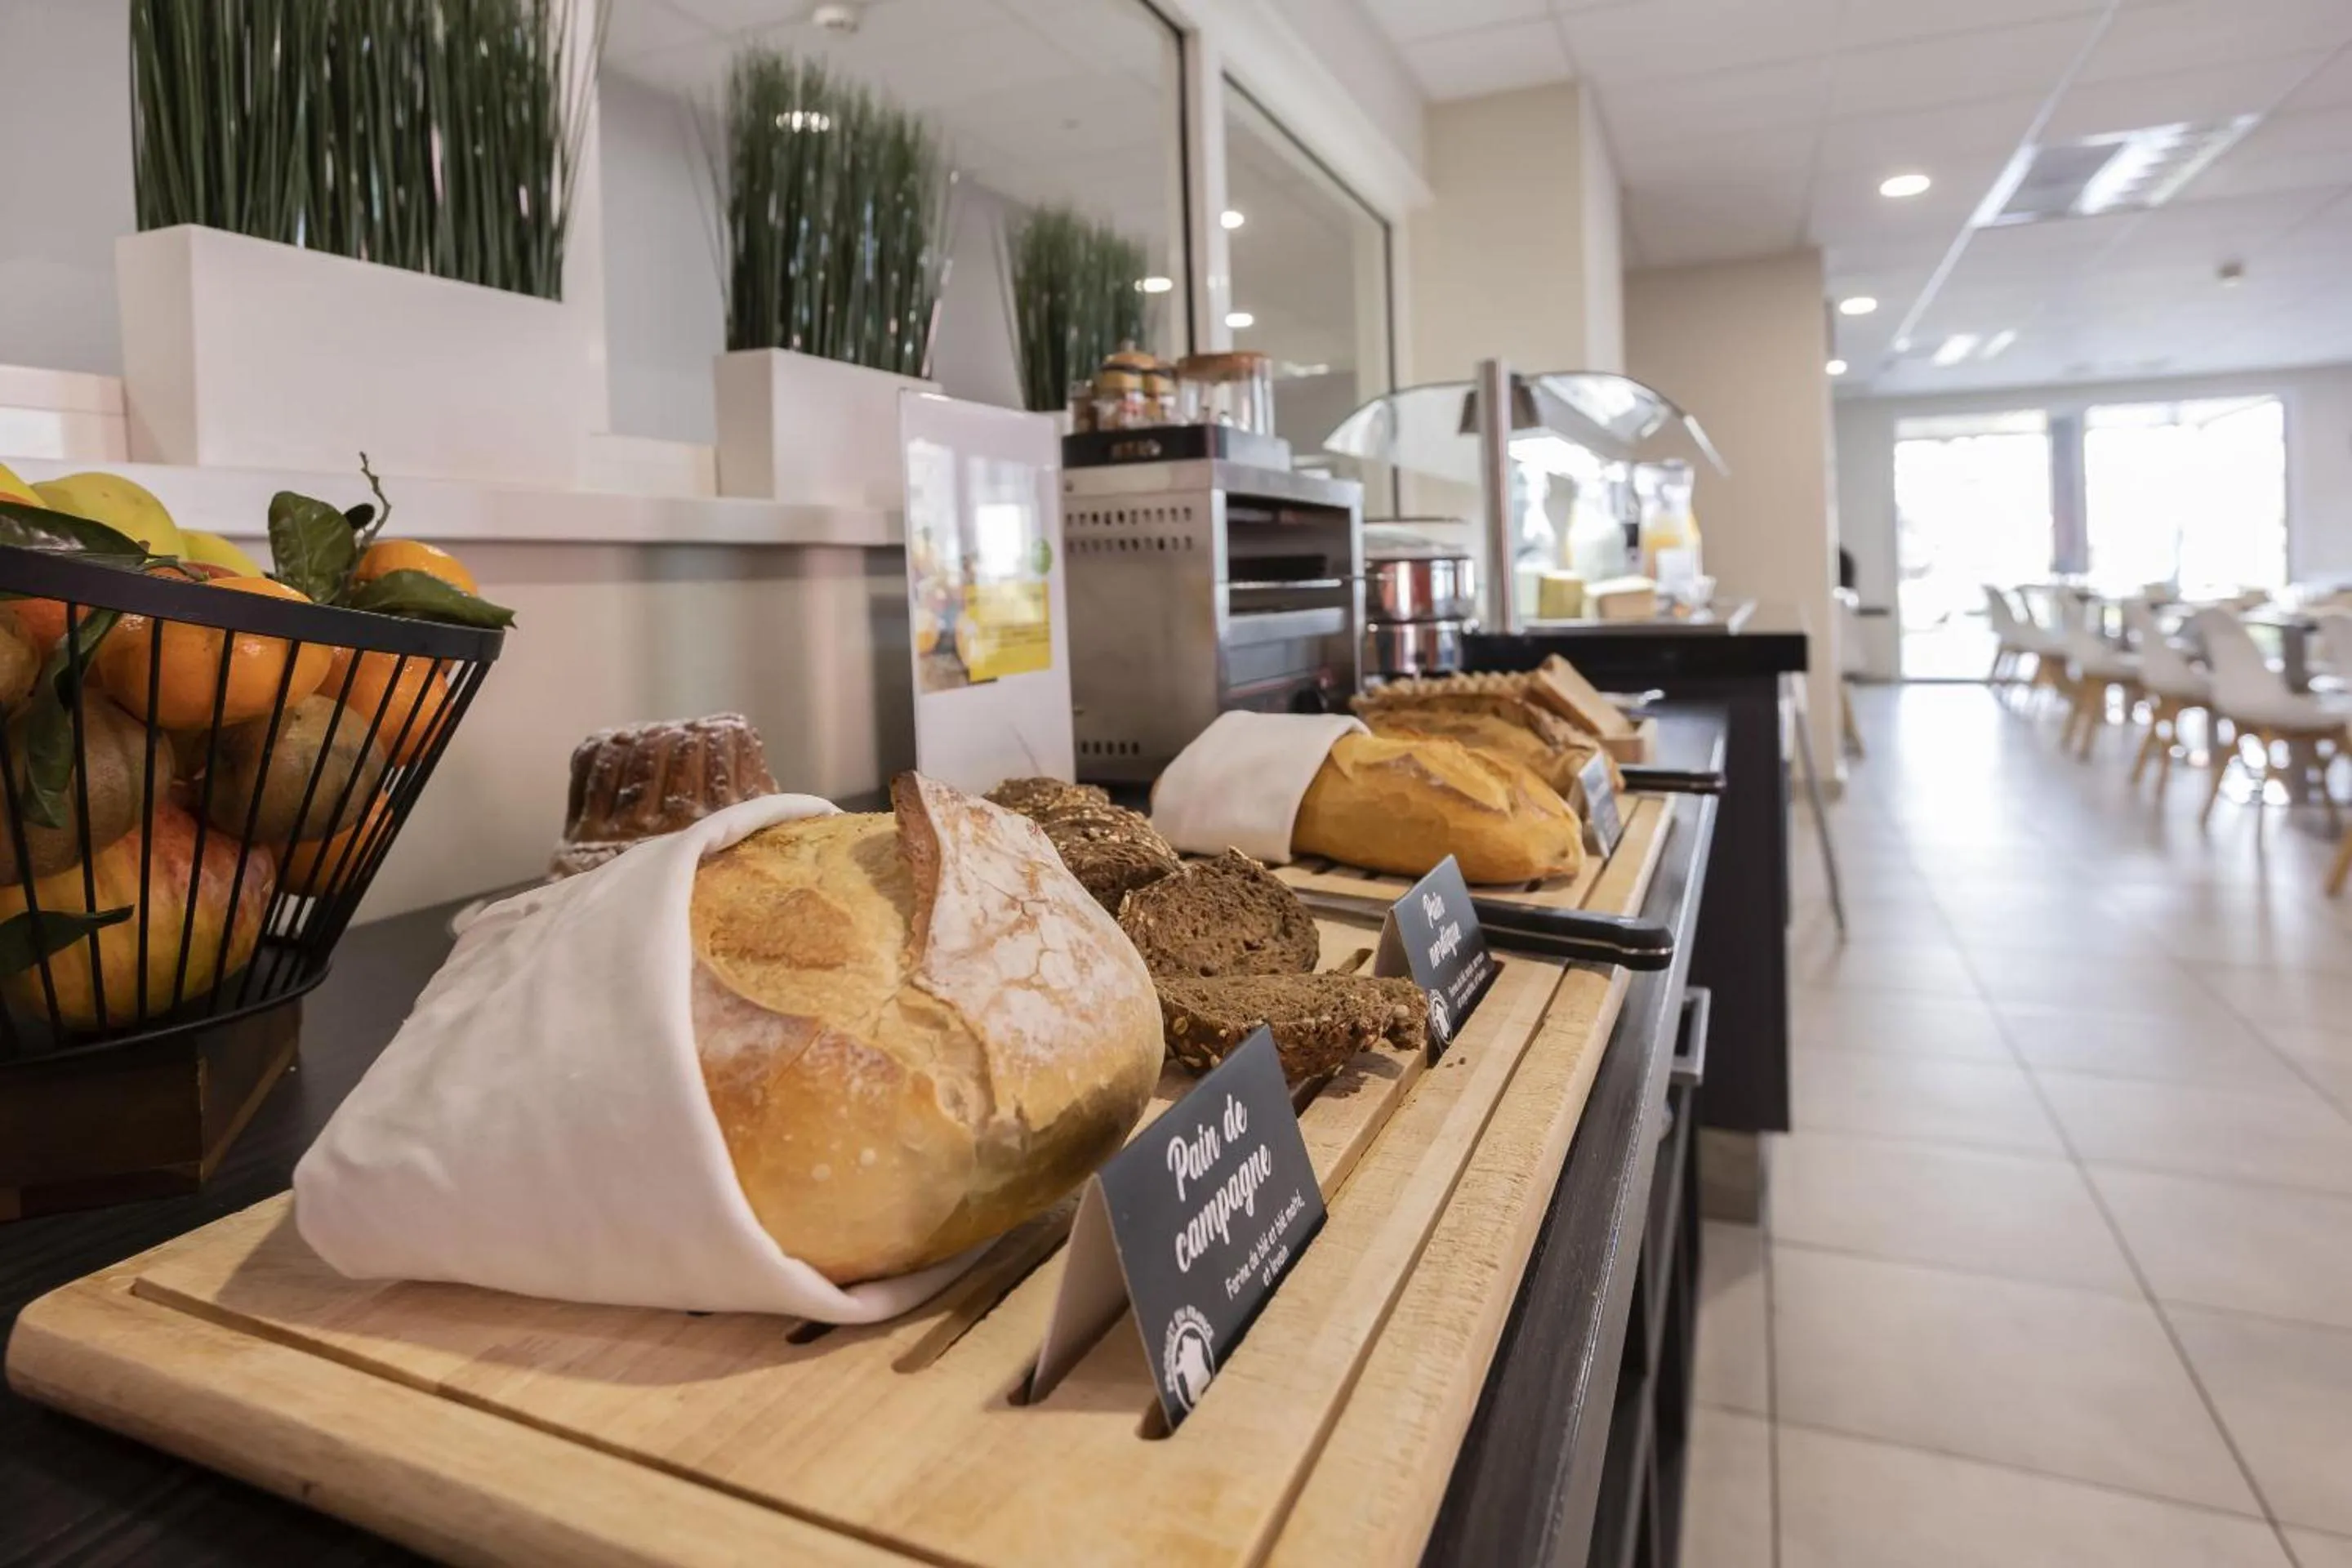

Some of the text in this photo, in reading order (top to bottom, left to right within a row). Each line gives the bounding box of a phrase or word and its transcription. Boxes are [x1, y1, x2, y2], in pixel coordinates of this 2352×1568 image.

[1167, 1093, 1248, 1203] Pain de
[1175, 1143, 1272, 1274] campagne
[1226, 1263, 1252, 1302] Farine
